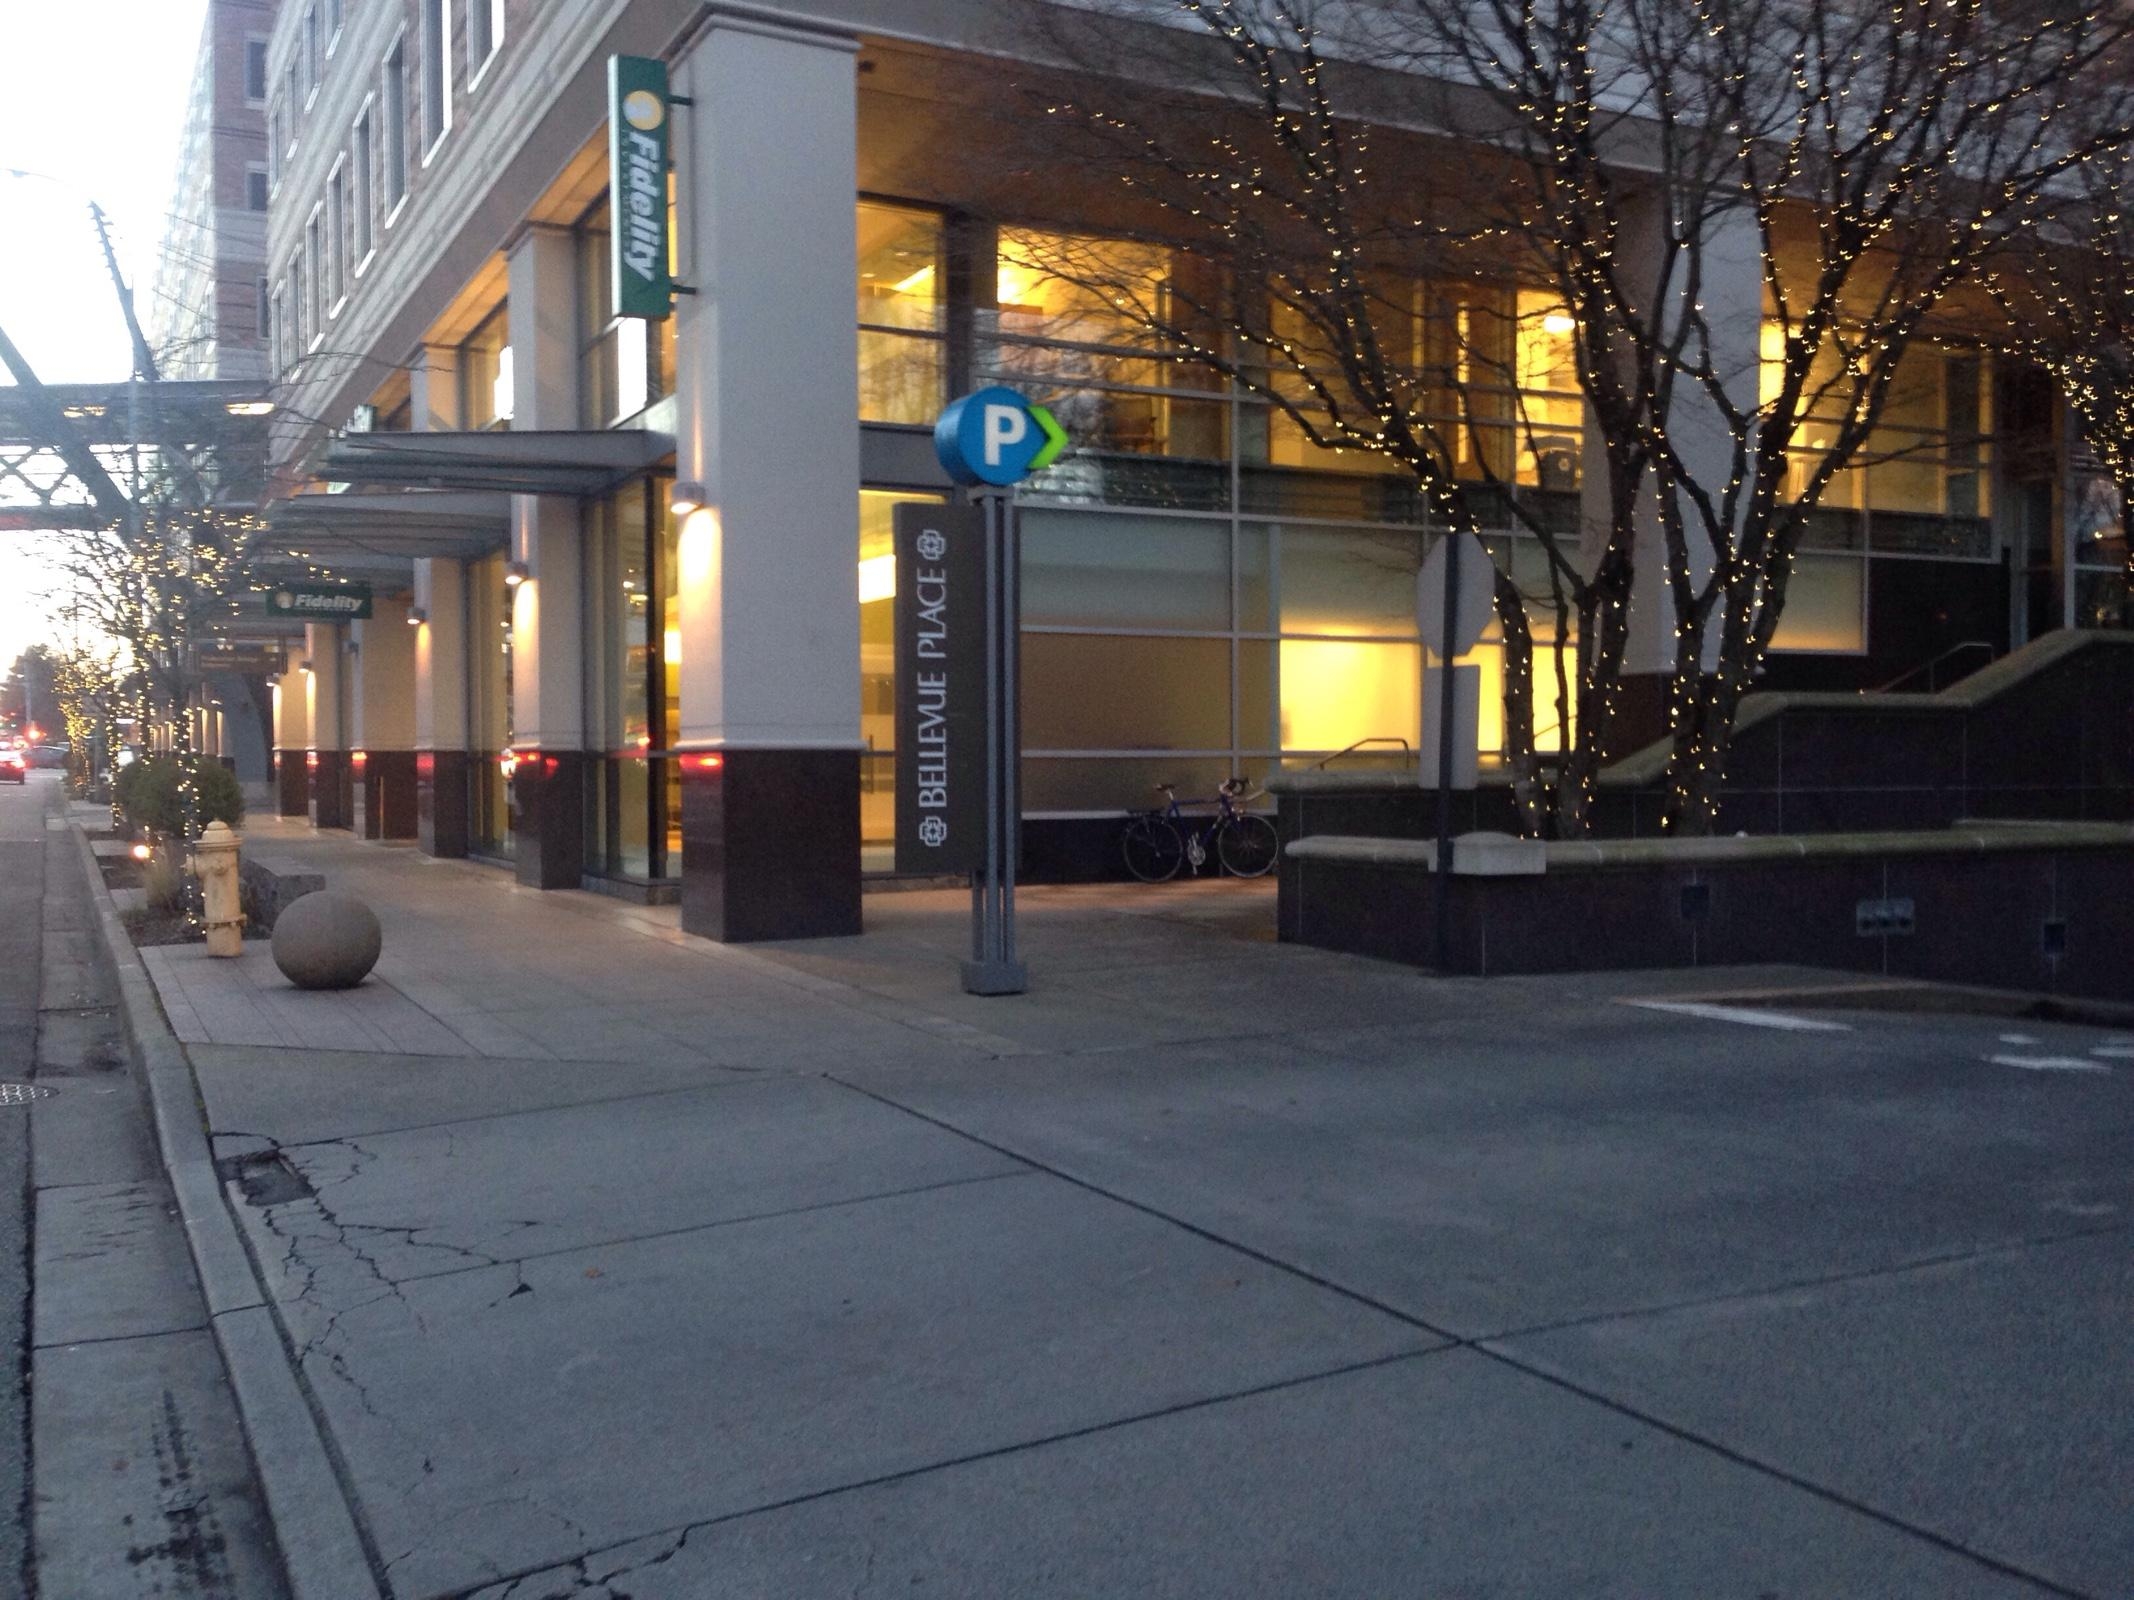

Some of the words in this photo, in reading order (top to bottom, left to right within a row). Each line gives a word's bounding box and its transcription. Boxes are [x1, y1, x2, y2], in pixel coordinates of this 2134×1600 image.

[623, 131, 660, 281] Fidelity
[985, 404, 1025, 466] P
[294, 594, 362, 612] Fidelity
[916, 568, 946, 658] PLACE
[917, 672, 947, 808] BELLEVUE
